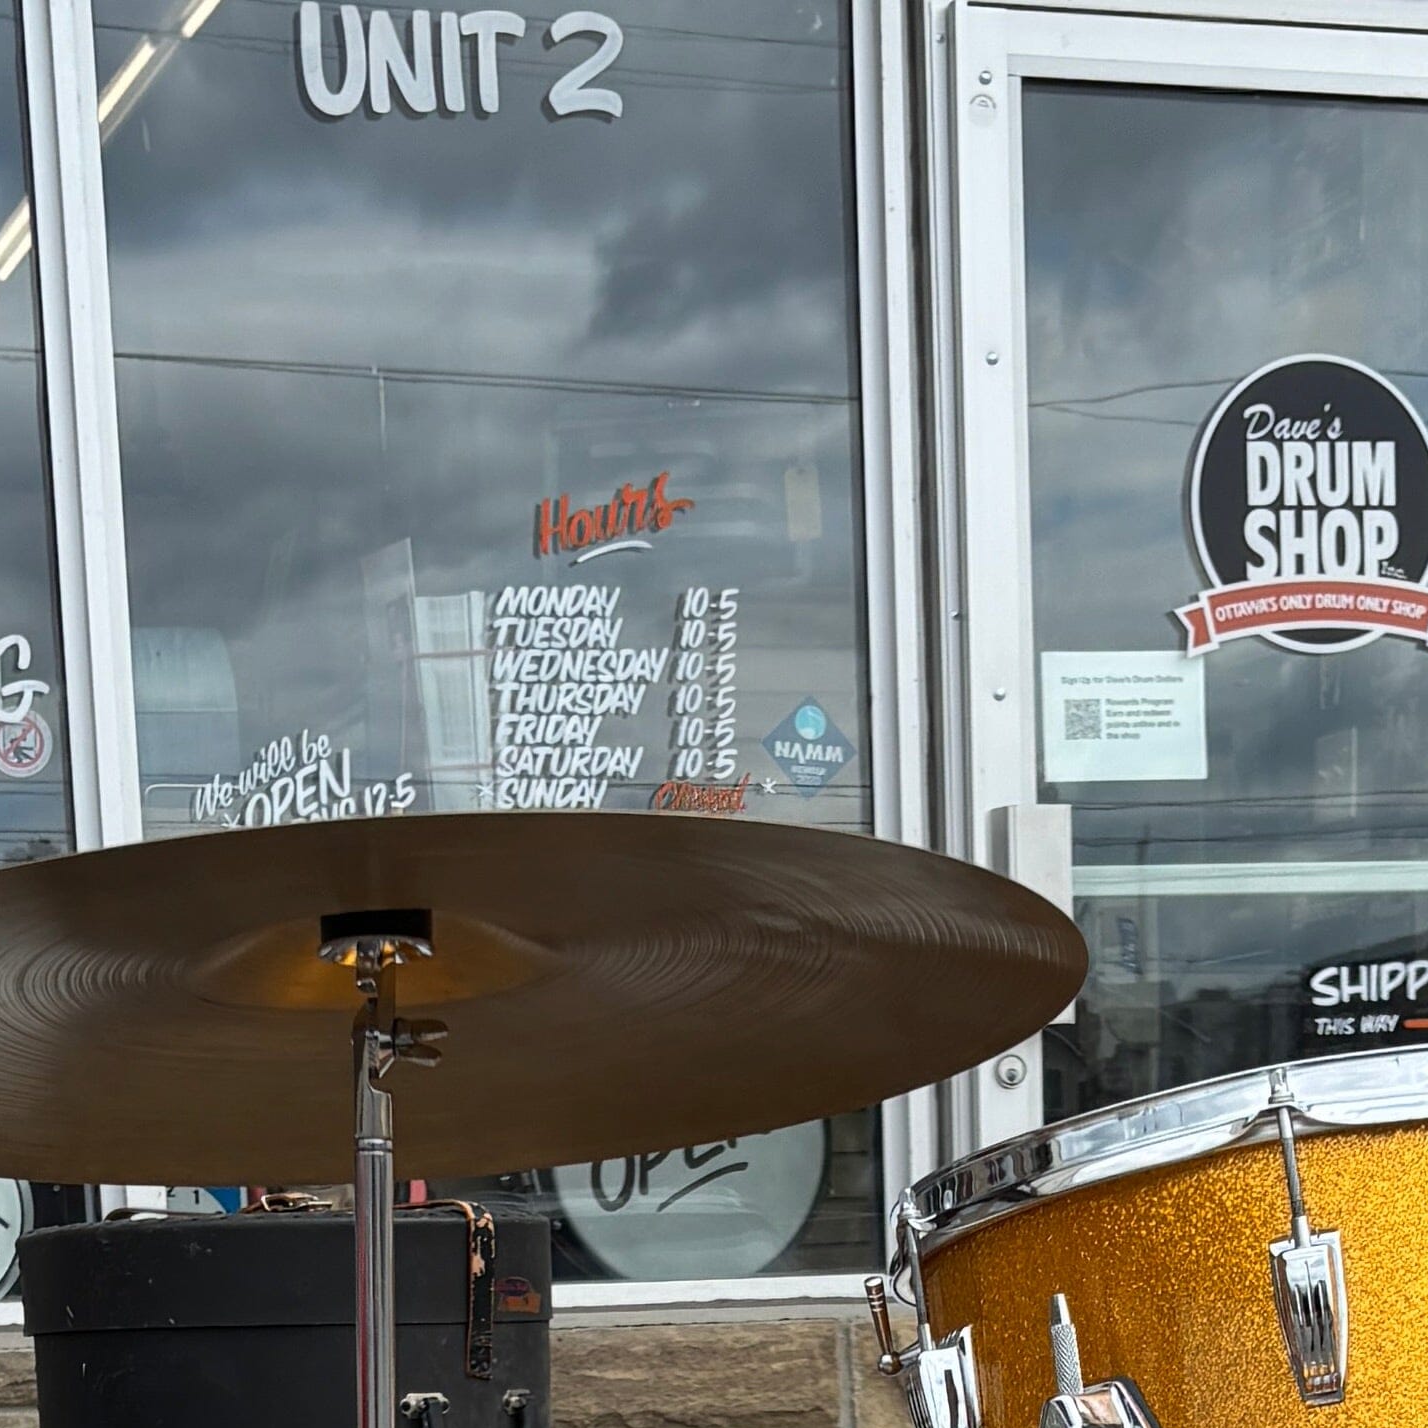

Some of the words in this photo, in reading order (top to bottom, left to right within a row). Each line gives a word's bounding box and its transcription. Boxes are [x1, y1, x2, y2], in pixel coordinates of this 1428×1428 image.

[300, 1, 526, 116] UNIT
[548, 10, 624, 118] 2
[1243, 403, 1344, 440] Dave's
[1246, 440, 1397, 507] DRUM
[539, 470, 696, 555] Hours
[1243, 508, 1400, 580] SHOP
[495, 585, 621, 616] MONDAY
[682, 587, 740, 620] 10-5
[1281, 594, 1314, 612] ONLY
[1314, 593, 1354, 609] DRUM
[1356, 595, 1391, 614] ONLY
[1390, 598, 1427, 620] SHOP
[492, 616, 623, 649] TUESDAY
[680, 620, 738, 652] 10-5
[492, 647, 669, 683] WEDNESDAY
[675, 652, 737, 685] 10-5
[495, 682, 647, 715] THURSDAY
[675, 684, 737, 719] 10-5
[495, 713, 603, 747] FRIDAY
[677, 717, 737, 748] 10-5
[495, 746, 644, 779] SATURDAY
[675, 748, 739, 780] 10-5
[774, 740, 845, 764] NAMM
[195, 773, 234, 821] We
[238, 736, 296, 796] will
[301, 728, 332, 765] be
[245, 747, 351, 826] OPEN
[495, 777, 609, 810] SUNDAY
[1314, 1016, 1356, 1036] THIS
[1359, 1014, 1401, 1034] WAY
